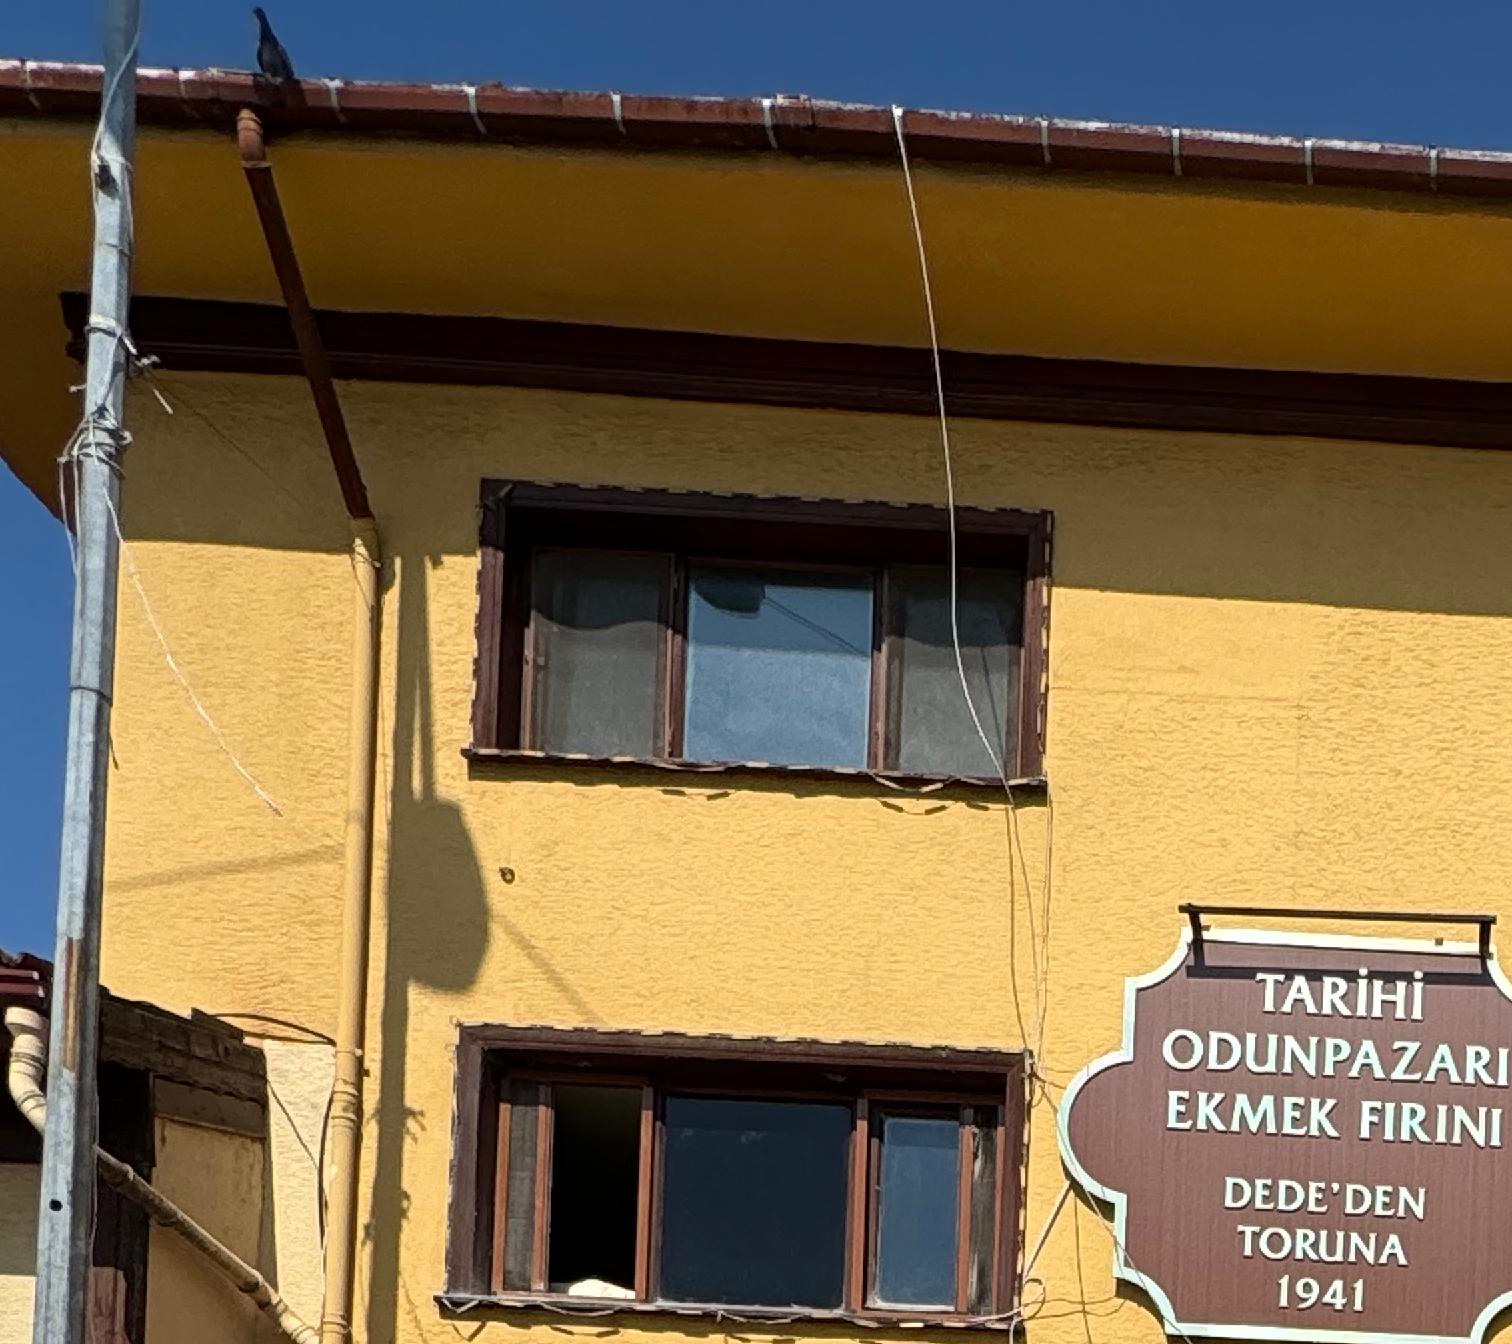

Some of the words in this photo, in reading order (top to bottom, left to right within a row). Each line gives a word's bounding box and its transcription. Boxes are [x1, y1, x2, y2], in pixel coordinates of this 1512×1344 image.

[1256, 967, 1425, 1021] TARİHİ
[1162, 1029, 1510, 1087] ODUNPAZARI
[1166, 1090, 1340, 1139] EKMEK
[1359, 1099, 1503, 1149] FIRINI
[1223, 1176, 1427, 1221] DEDE'DEN
[1237, 1225, 1409, 1267] TORUNA
[1277, 1274, 1365, 1313] 1941
